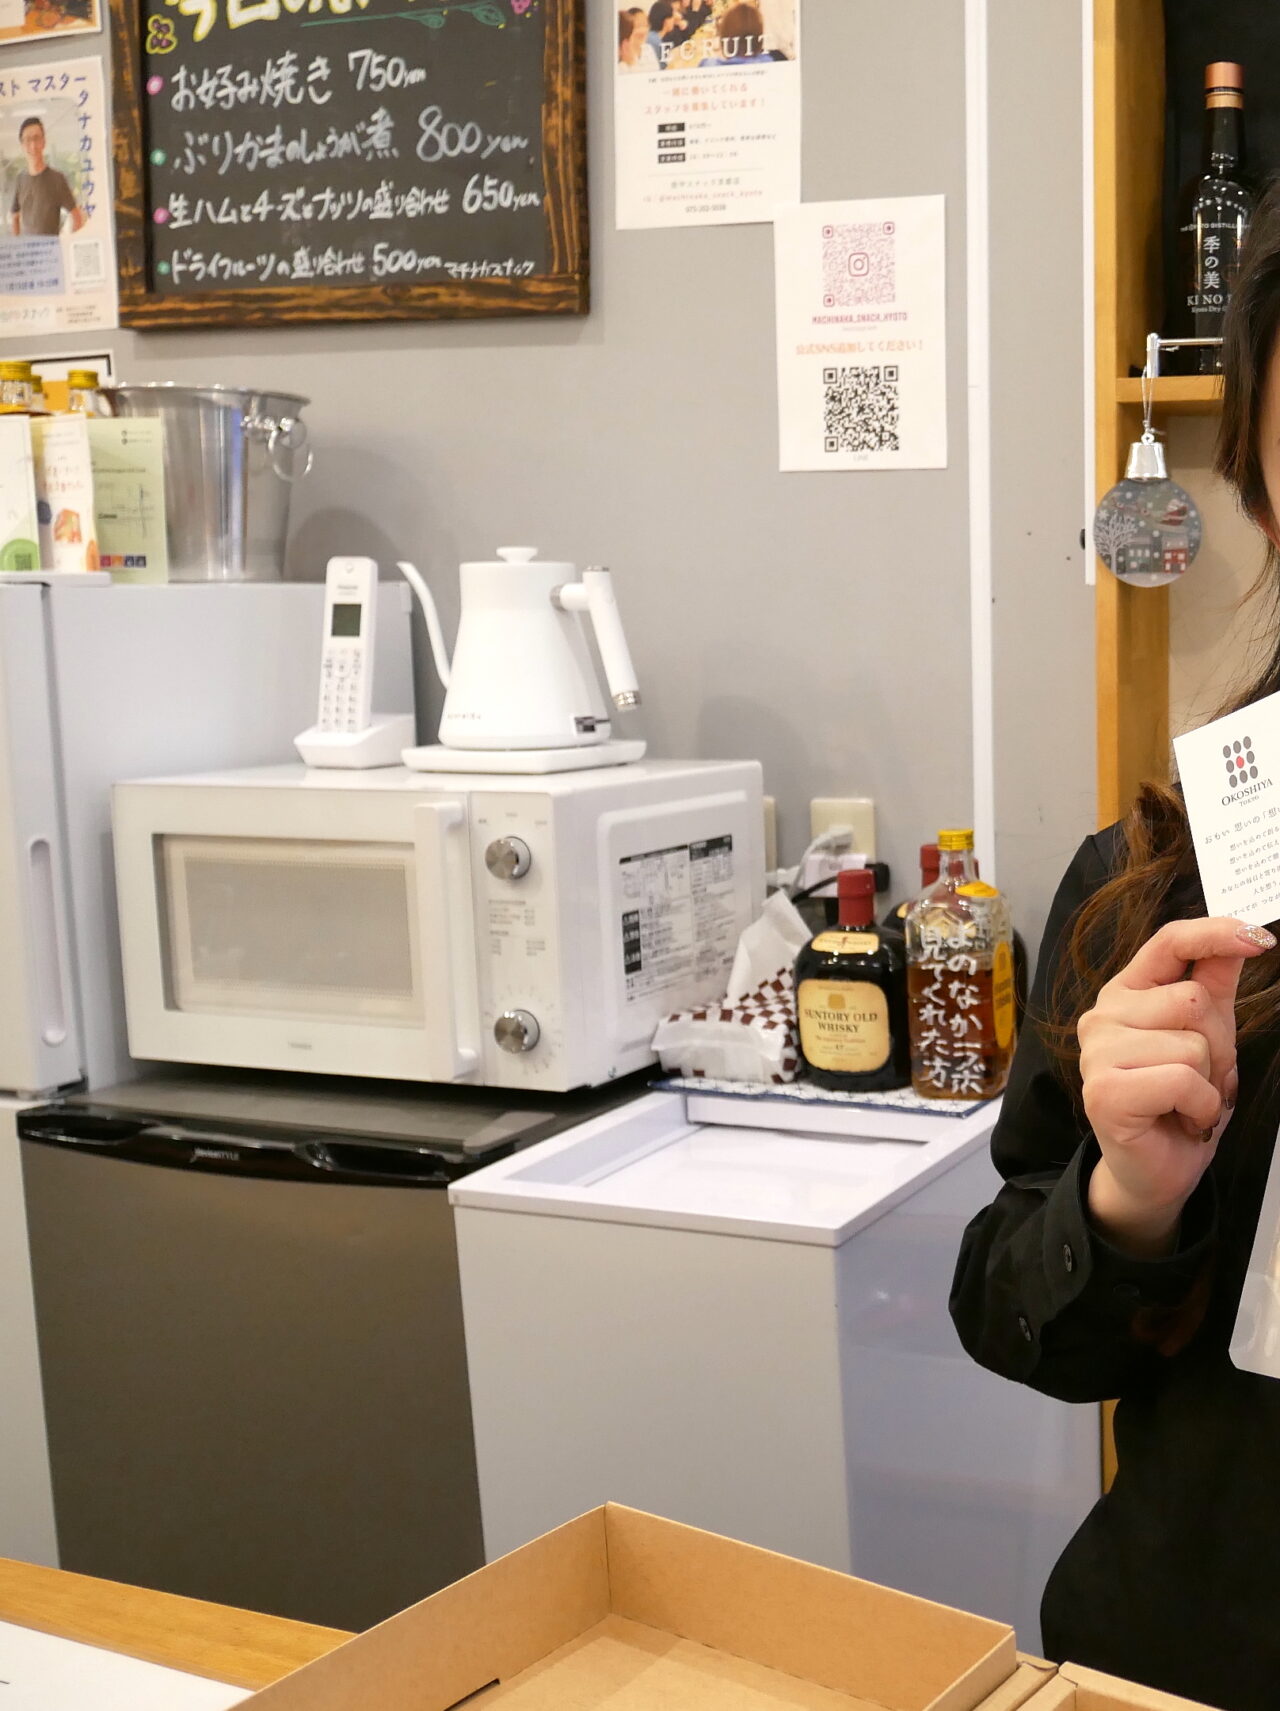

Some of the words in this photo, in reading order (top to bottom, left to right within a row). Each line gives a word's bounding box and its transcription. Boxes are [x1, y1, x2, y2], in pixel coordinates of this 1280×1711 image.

[28, 72, 87, 93] マスター
[170, 49, 333, 112] お好み焼き
[77, 89, 96, 220] タナカユウヤ
[174, 106, 400, 175] ぶりかまのしょうが煮
[1203, 235, 1221, 289] 季の美
[1187, 294, 1199, 306] KI
[1203, 294, 1223, 305] NO
[1221, 778, 1273, 806] OKOSHIYA
[1239, 795, 1260, 807] TOKYO
[804, 1008, 850, 1023] SUNTORY
[853, 1012, 878, 1023] OLD
[919, 925, 952, 1089] 見てくれた方
[818, 1022, 860, 1033] WHISKY
